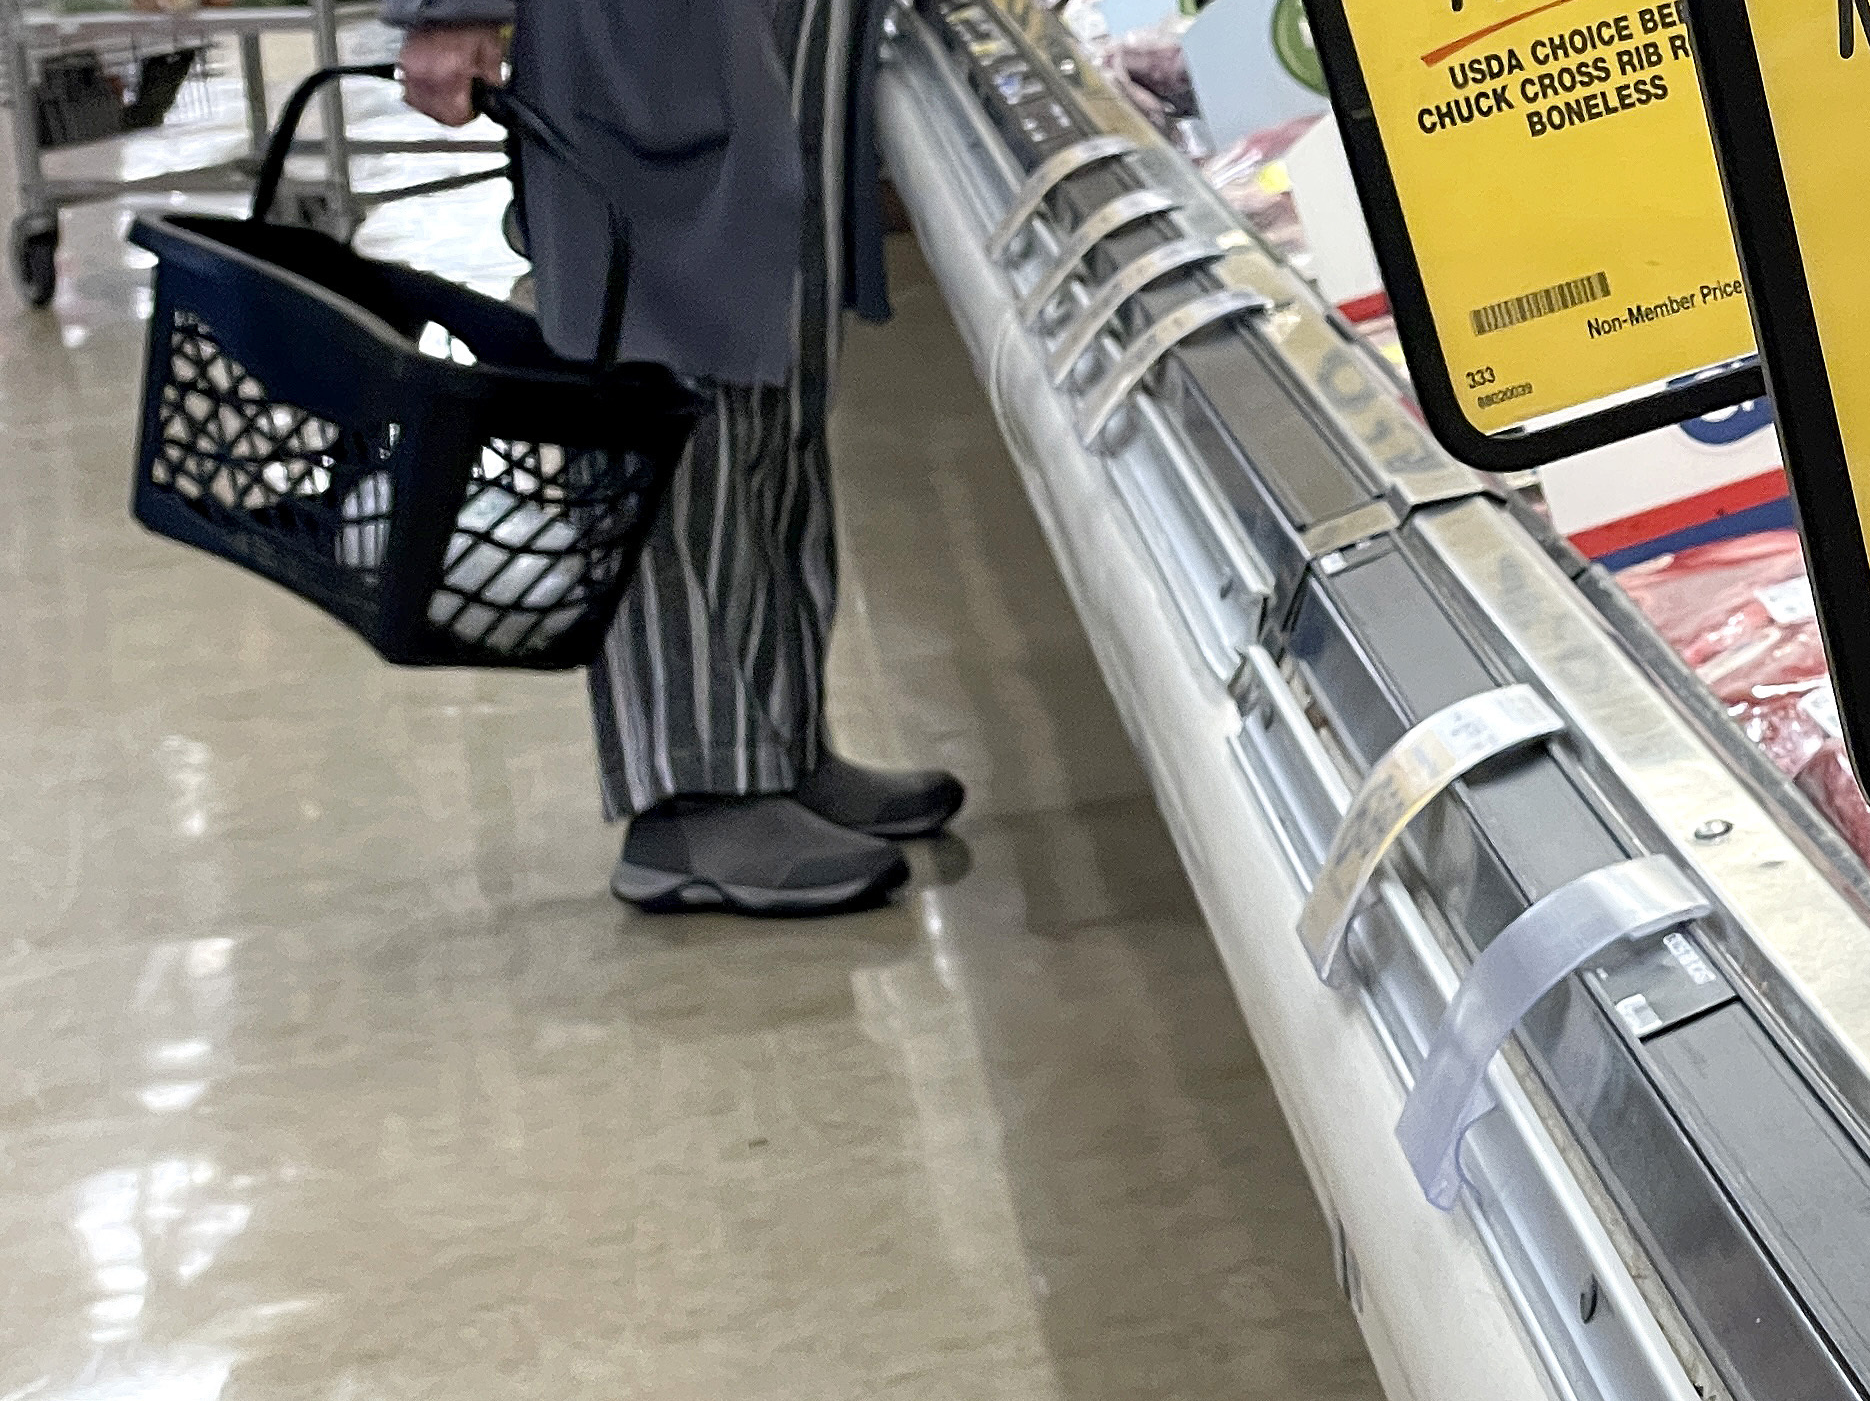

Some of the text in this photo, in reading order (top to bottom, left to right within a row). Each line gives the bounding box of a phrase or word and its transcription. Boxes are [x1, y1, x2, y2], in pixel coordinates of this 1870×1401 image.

[1449, 53, 1524, 91] USDA
[1531, 15, 1634, 69] CHOICE
[1638, 0, 1681, 35] BE
[1417, 90, 1515, 135] CHUCK
[1521, 56, 1610, 107] CROSS
[1616, 41, 1663, 75] RIB
[1525, 74, 1669, 138] BONELESS
[1587, 280, 1743, 339] Non-Member Price
[1465, 366, 1496, 389] 333
